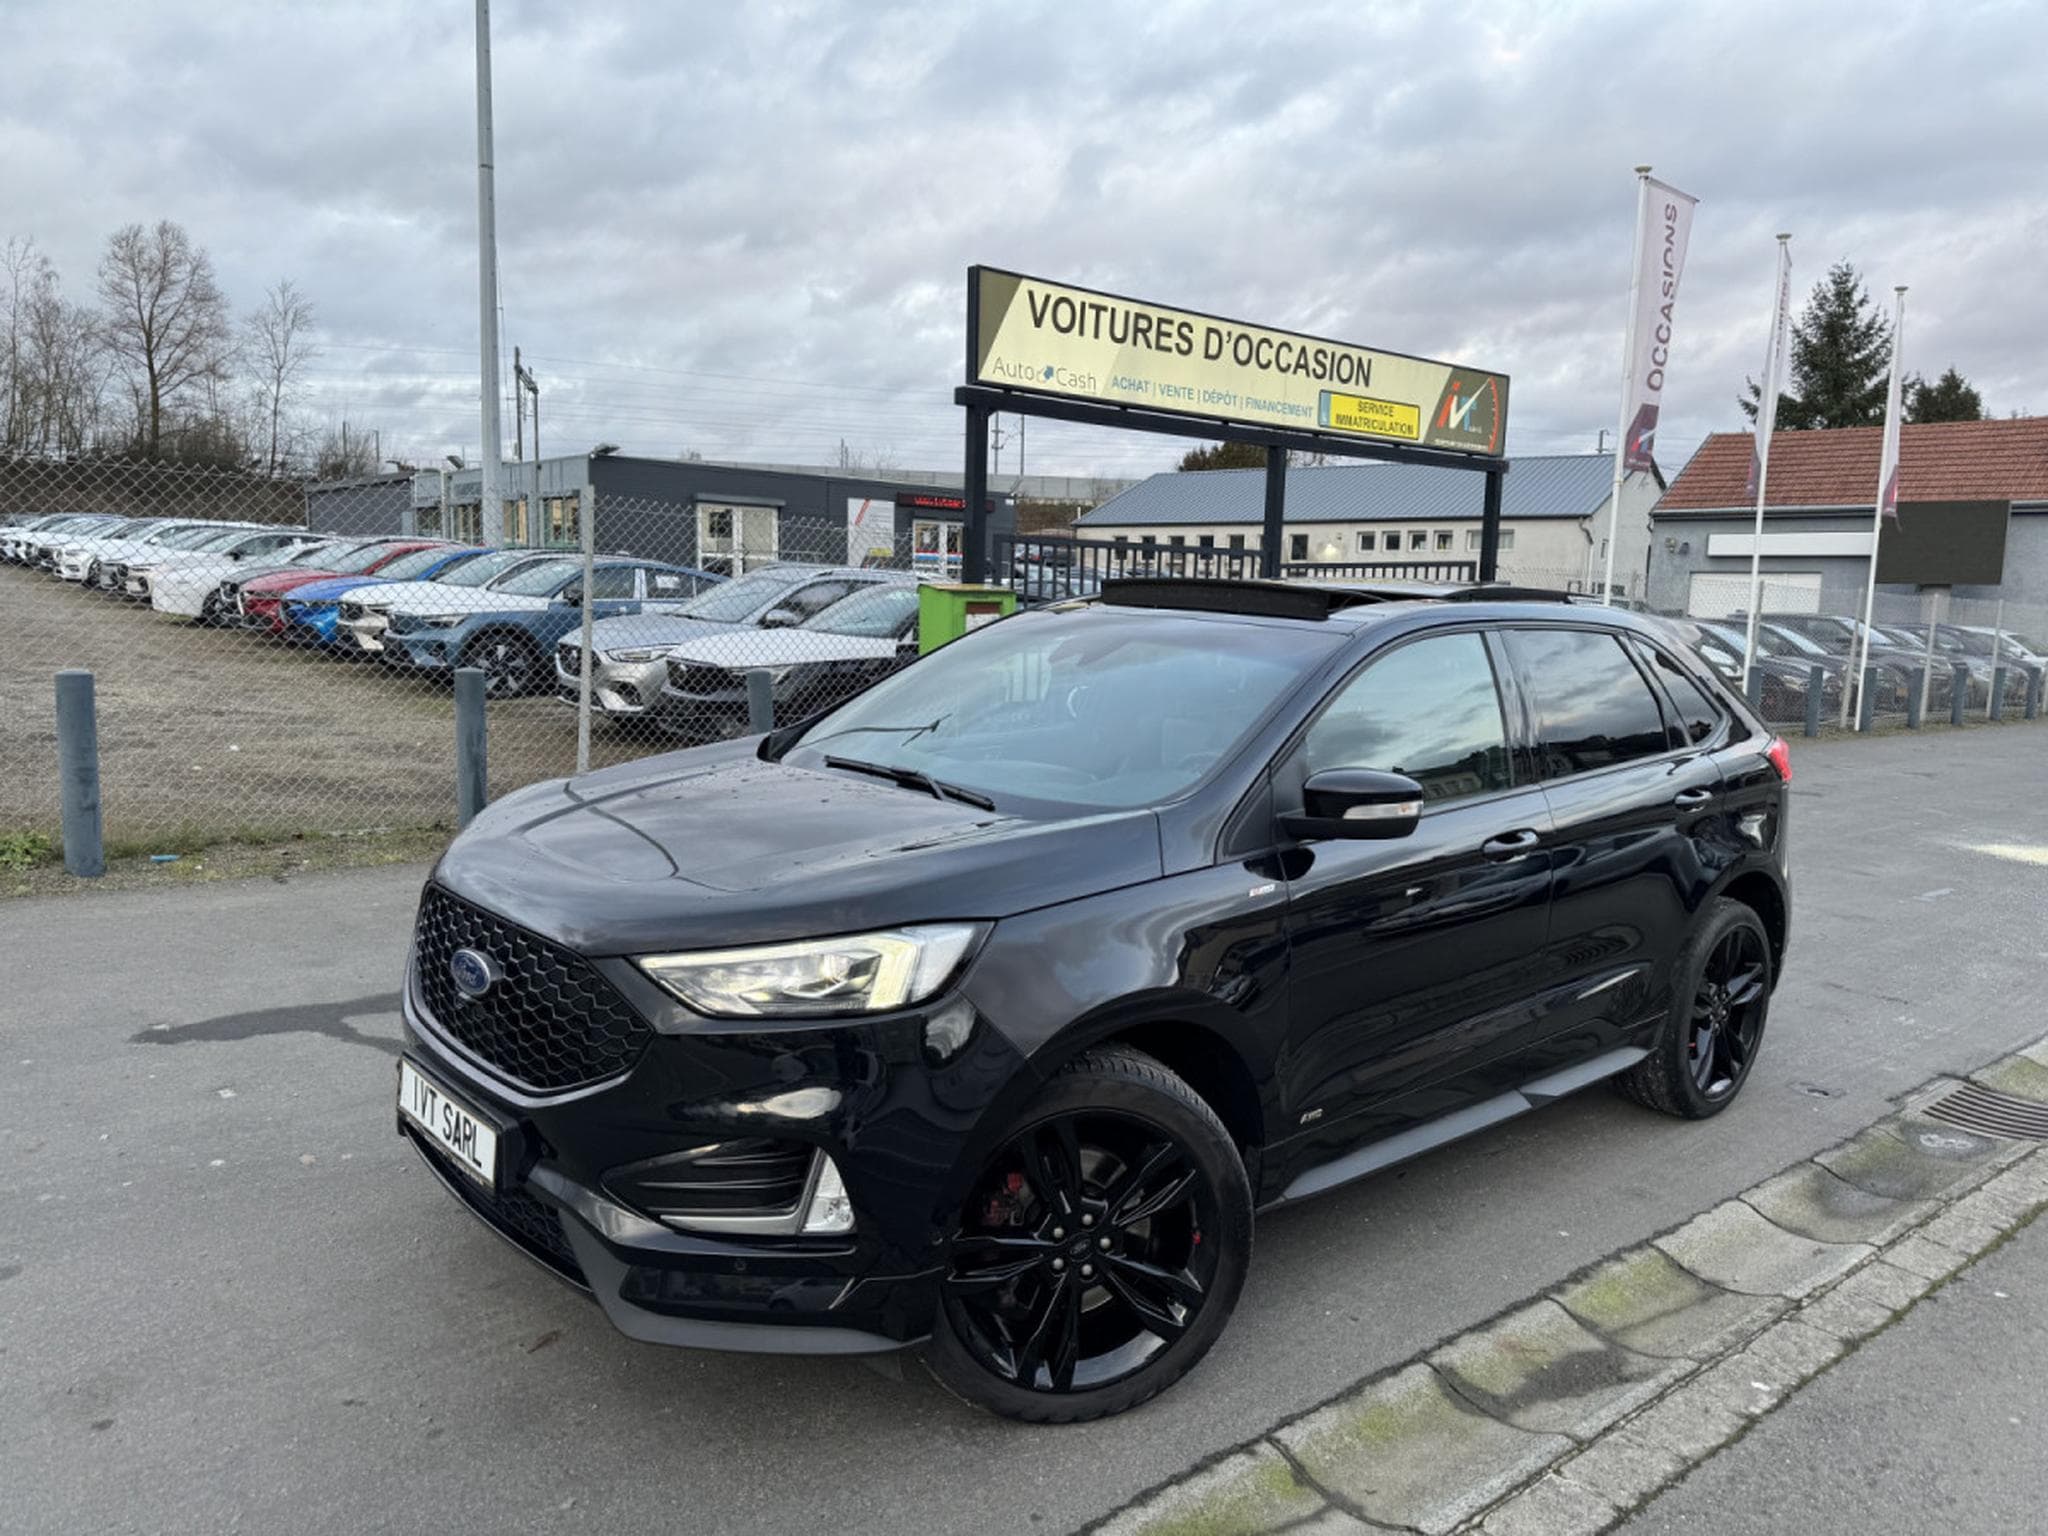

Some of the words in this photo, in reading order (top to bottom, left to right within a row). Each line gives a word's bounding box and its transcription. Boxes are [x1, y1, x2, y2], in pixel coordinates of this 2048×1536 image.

[1646, 202, 1678, 392] OCCASIONS
[1028, 290, 1194, 356] VOITURES
[1204, 326, 1372, 388] D'OCCASION
[1056, 367, 1097, 391] Cash
[1112, 376, 1149, 393] ACHAT
[1159, 384, 1194, 401] VENTE
[1202, 388, 1238, 407] DÉPÔT
[1245, 396, 1314, 418] FINANCEMENT
[1335, 414, 1414, 436] IMMATRICULATION
[1357, 400, 1395, 418] SERVICE
[413, 1075, 438, 1127] IVT
[443, 1102, 482, 1169] SARL
